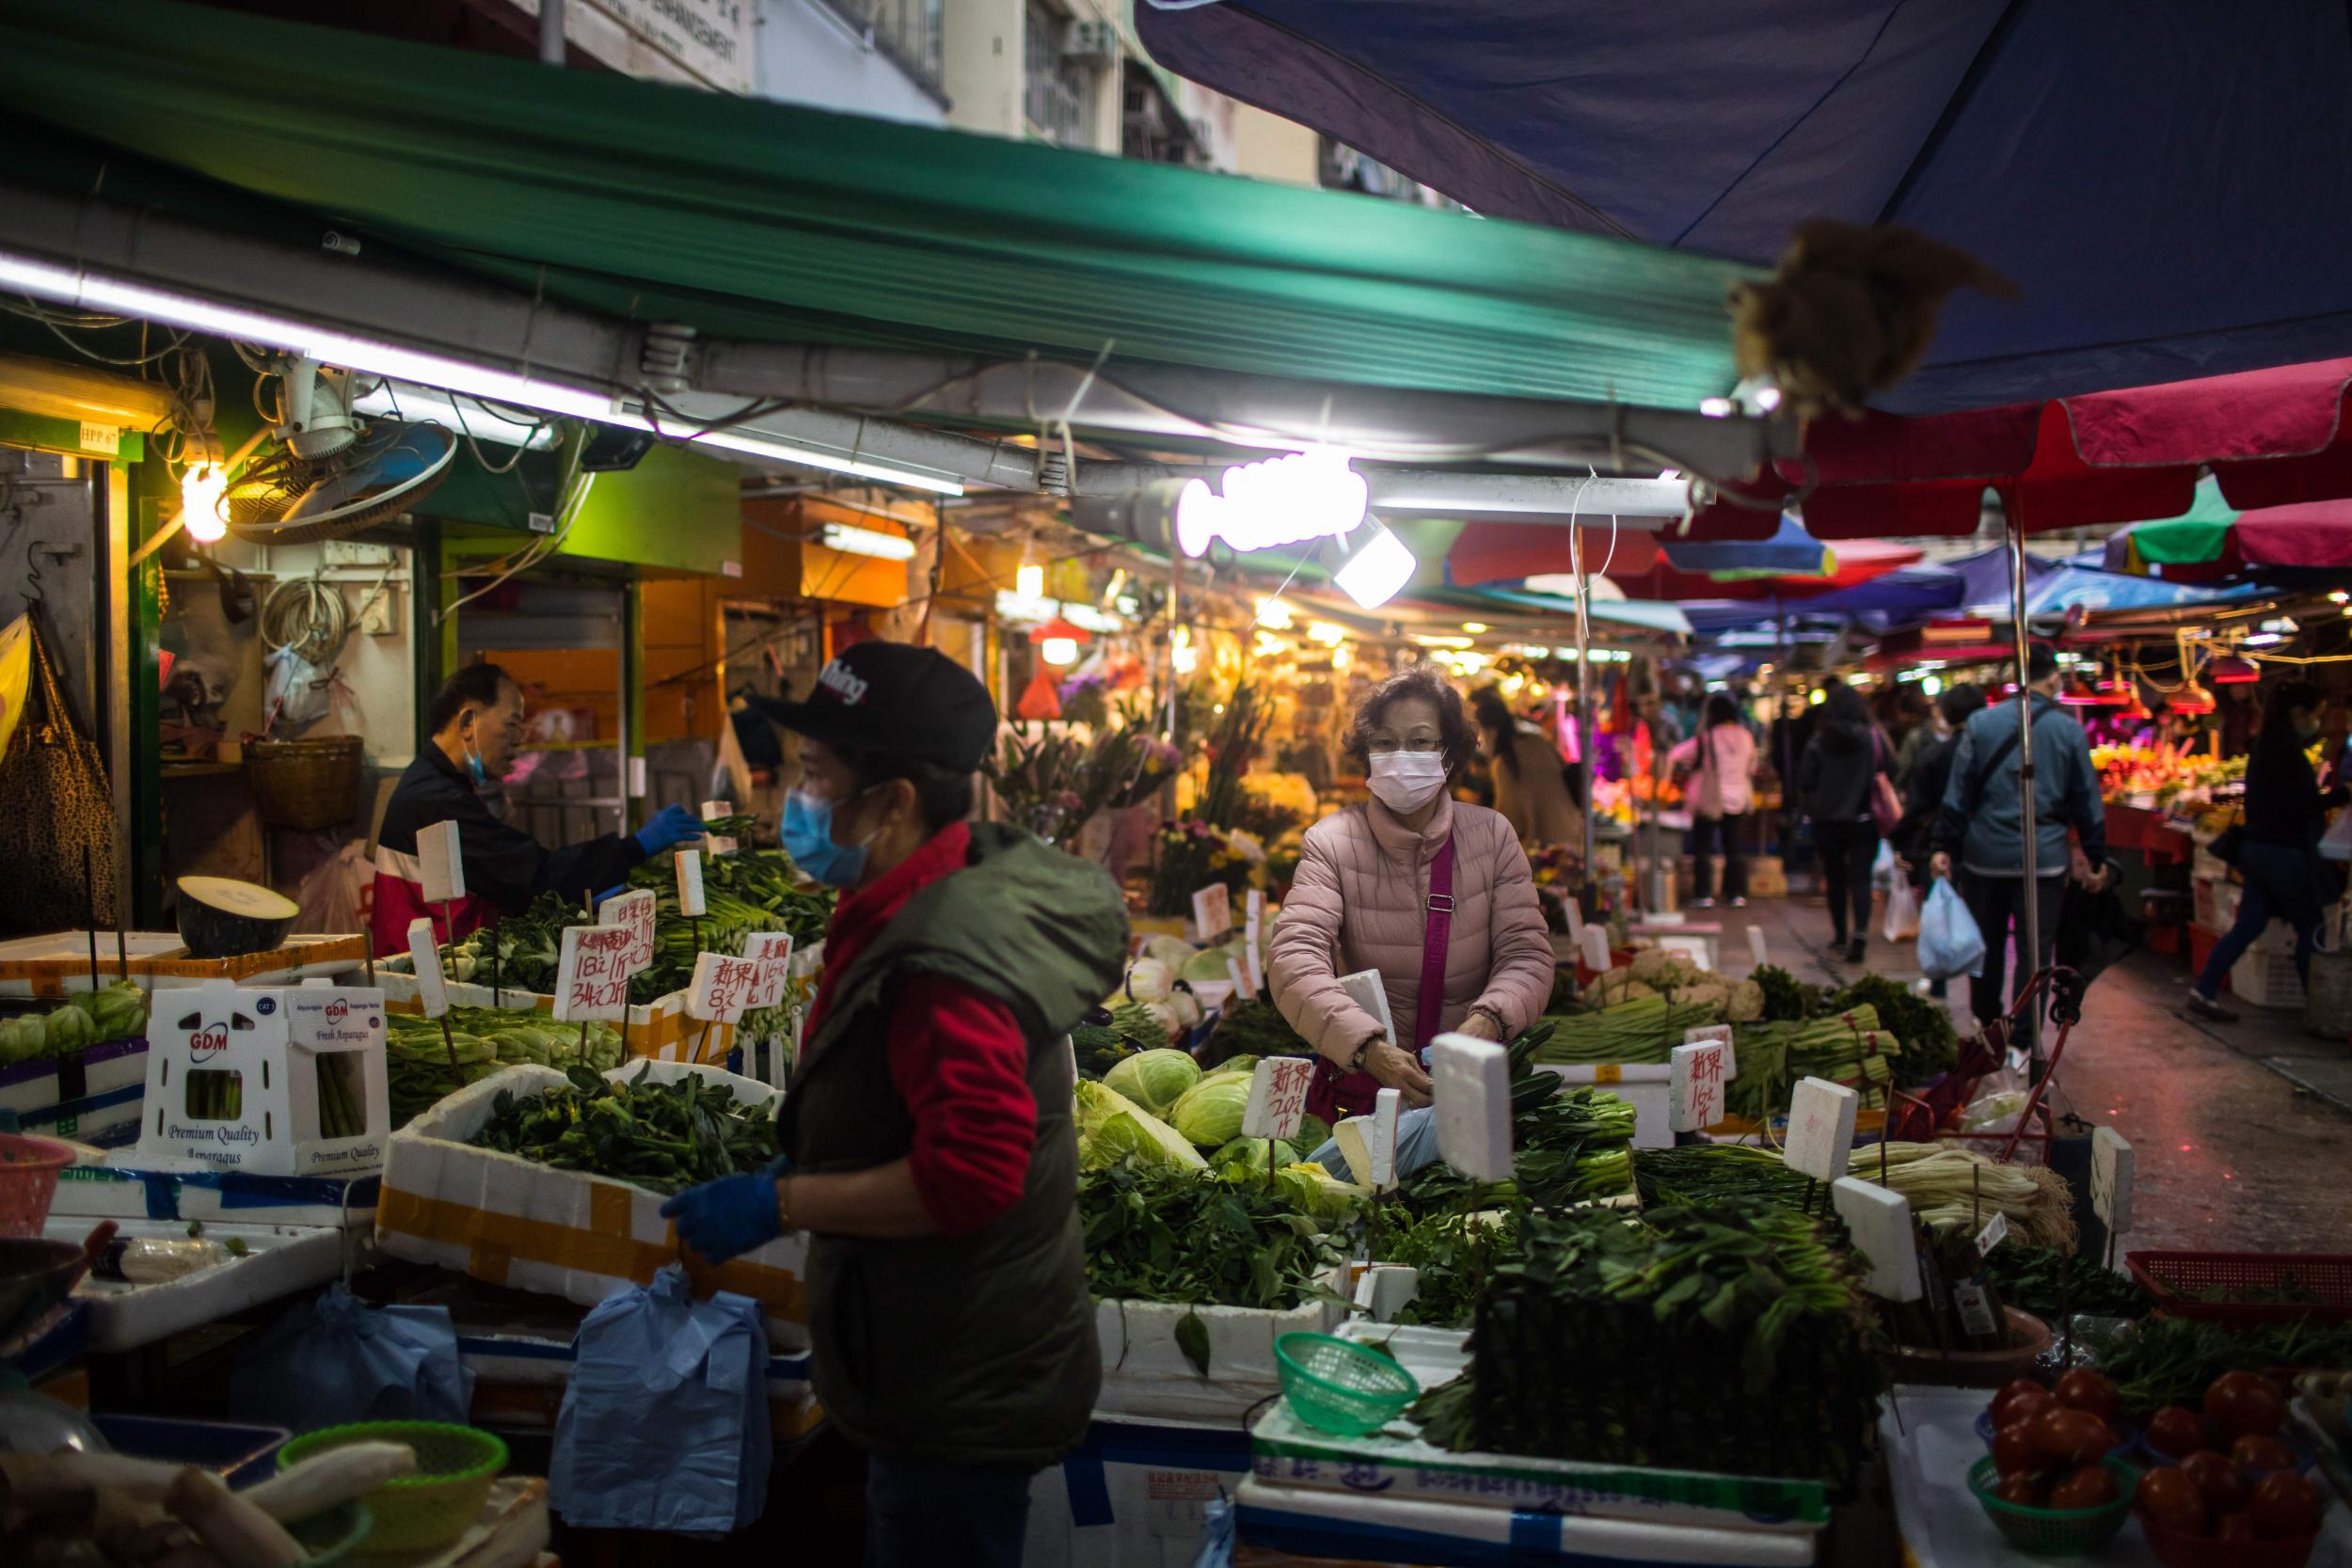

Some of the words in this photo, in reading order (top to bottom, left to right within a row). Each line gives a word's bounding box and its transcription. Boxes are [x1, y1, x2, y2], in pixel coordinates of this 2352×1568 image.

[81, 428, 103, 443] HPP
[325, 1006, 348, 1017] GDM
[190, 1033, 228, 1052] GDM
[315, 1029, 335, 1040] Fresh
[337, 1030, 369, 1042] Asparagus
[1690, 1048, 1724, 1085] 新界
[1270, 1061, 1311, 1096] 新界
[167, 1124, 214, 1141] Premium
[217, 1125, 260, 1147] Quality
[310, 1150, 348, 1164] Premium
[350, 1144, 379, 1162] Quality
